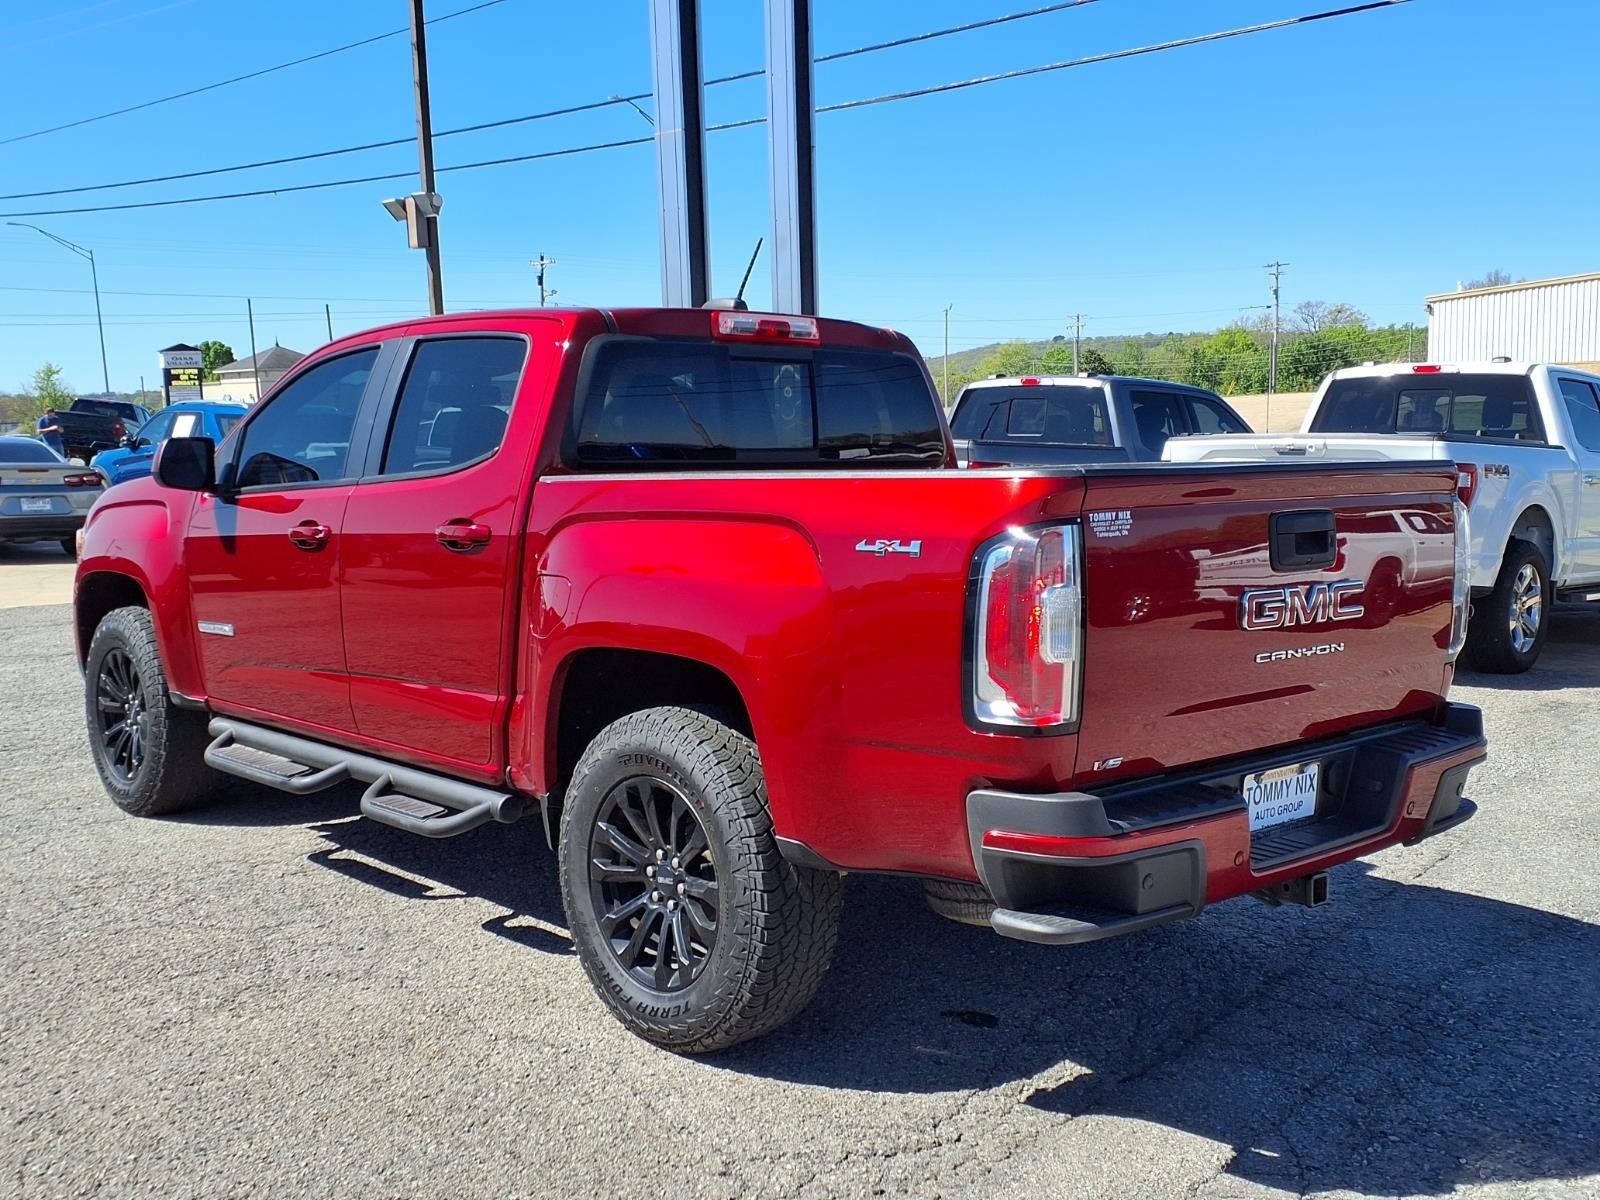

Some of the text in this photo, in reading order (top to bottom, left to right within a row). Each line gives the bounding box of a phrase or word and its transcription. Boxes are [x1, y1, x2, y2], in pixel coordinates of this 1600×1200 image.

[1484, 463, 1510, 478] FX4
[1089, 510, 1131, 521] TOMMY NIX
[1241, 580, 1365, 630] GMC
[1254, 642, 1345, 663] CANYON
[1093, 757, 1124, 772] V6
[1246, 777, 1293, 807] TOMMY
[1295, 772, 1317, 796] NIX
[1254, 800, 1304, 822] AUTO GROUP
